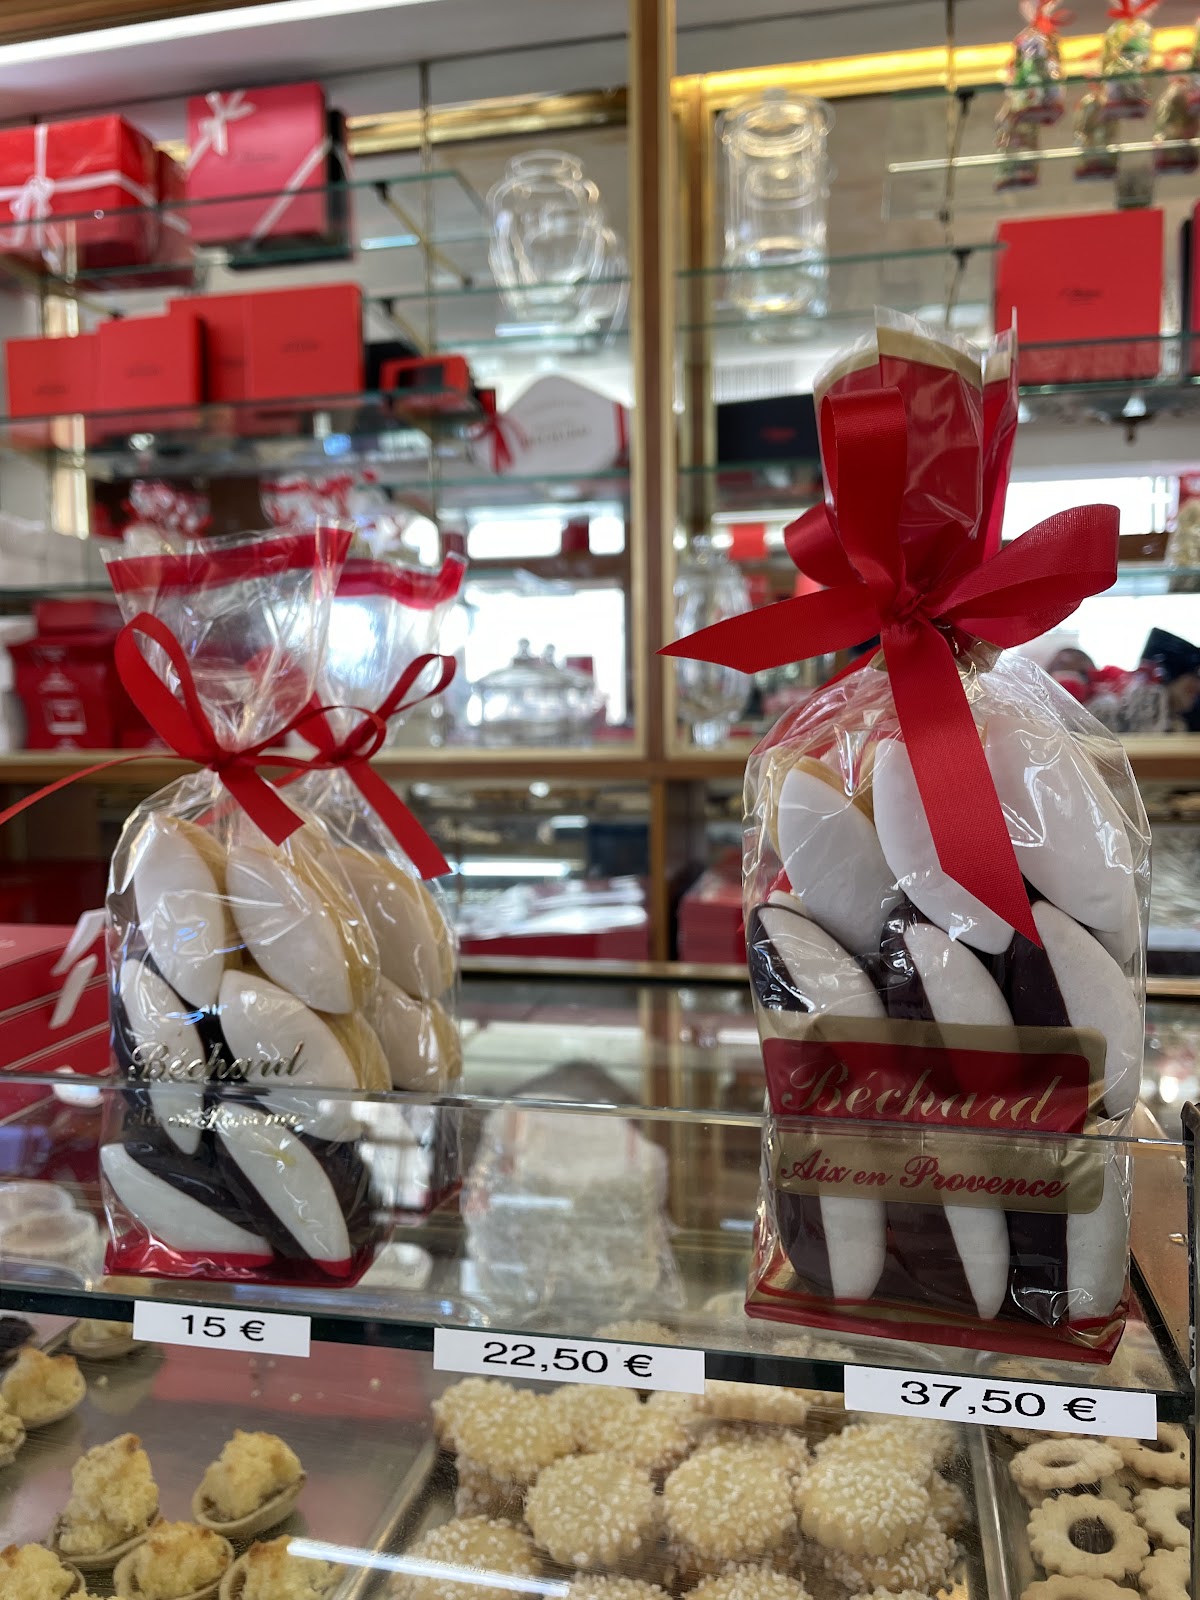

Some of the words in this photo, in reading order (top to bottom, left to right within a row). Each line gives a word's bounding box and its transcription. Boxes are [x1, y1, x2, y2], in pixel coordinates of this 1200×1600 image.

[128, 1040, 307, 1083] Béchard
[782, 1061, 1062, 1124] Béchard
[781, 1149, 852, 1183] Aix
[853, 1170, 892, 1187] en
[900, 1155, 1070, 1198] Provence
[181, 1314, 226, 1338] 15
[239, 1320, 265, 1342] €
[482, 1341, 609, 1374] 22,50
[623, 1354, 653, 1378] €
[900, 1380, 1046, 1417] 37,50
[1062, 1397, 1097, 1422] €
